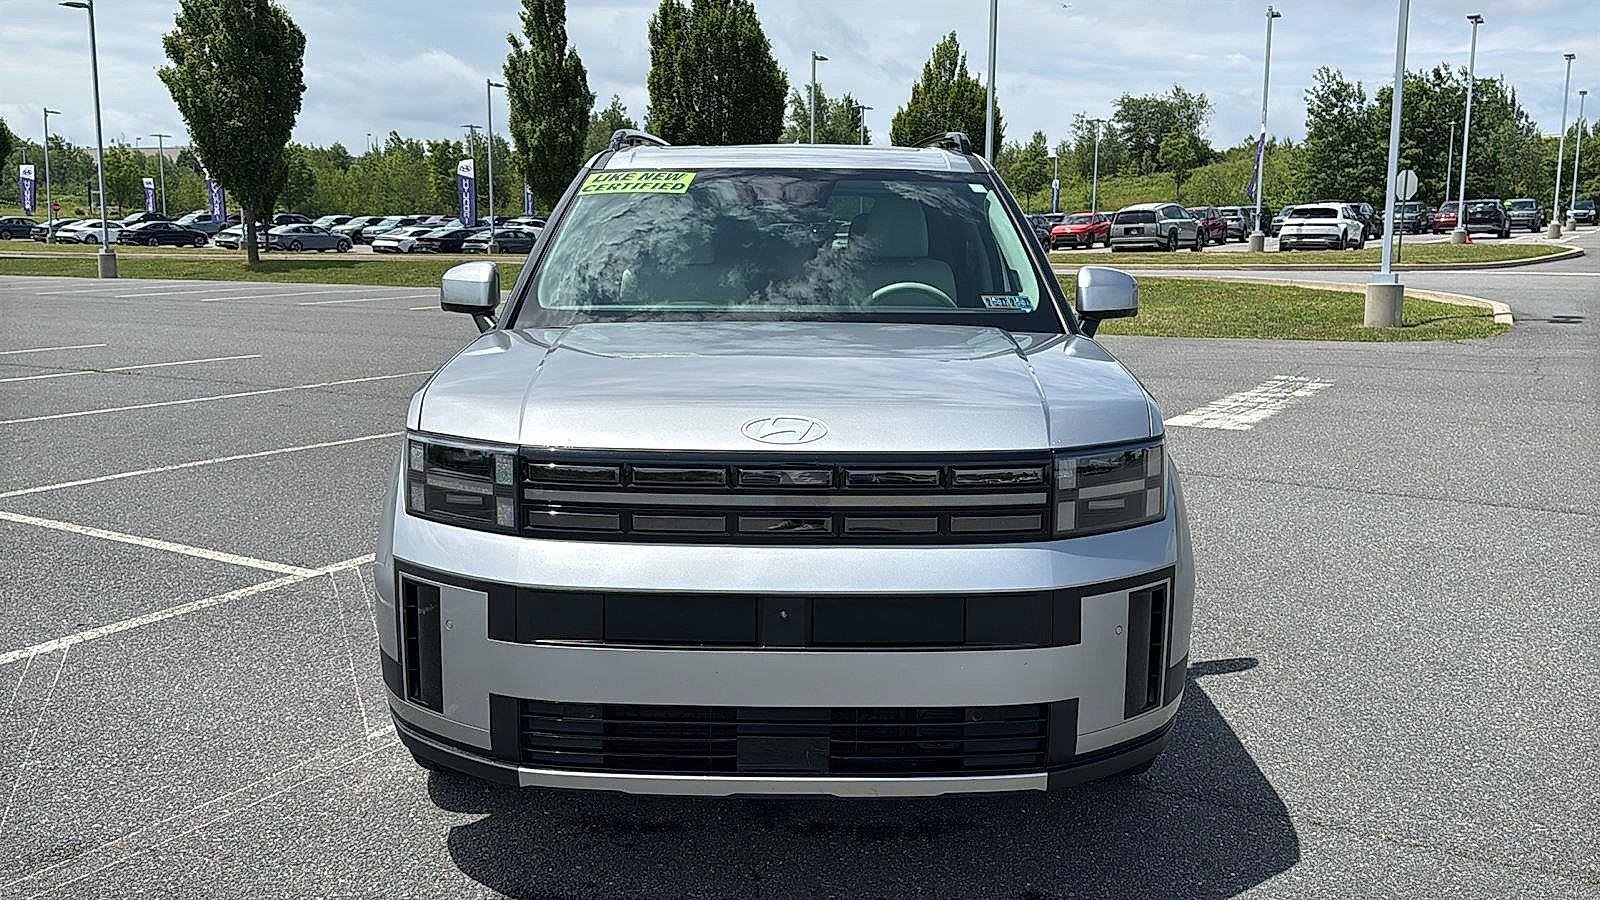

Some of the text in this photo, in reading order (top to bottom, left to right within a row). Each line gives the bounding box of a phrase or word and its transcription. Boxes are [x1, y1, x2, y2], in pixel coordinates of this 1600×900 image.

[592, 172, 686, 183] LIKE NEW
[581, 182, 686, 192] CERTIFIED
